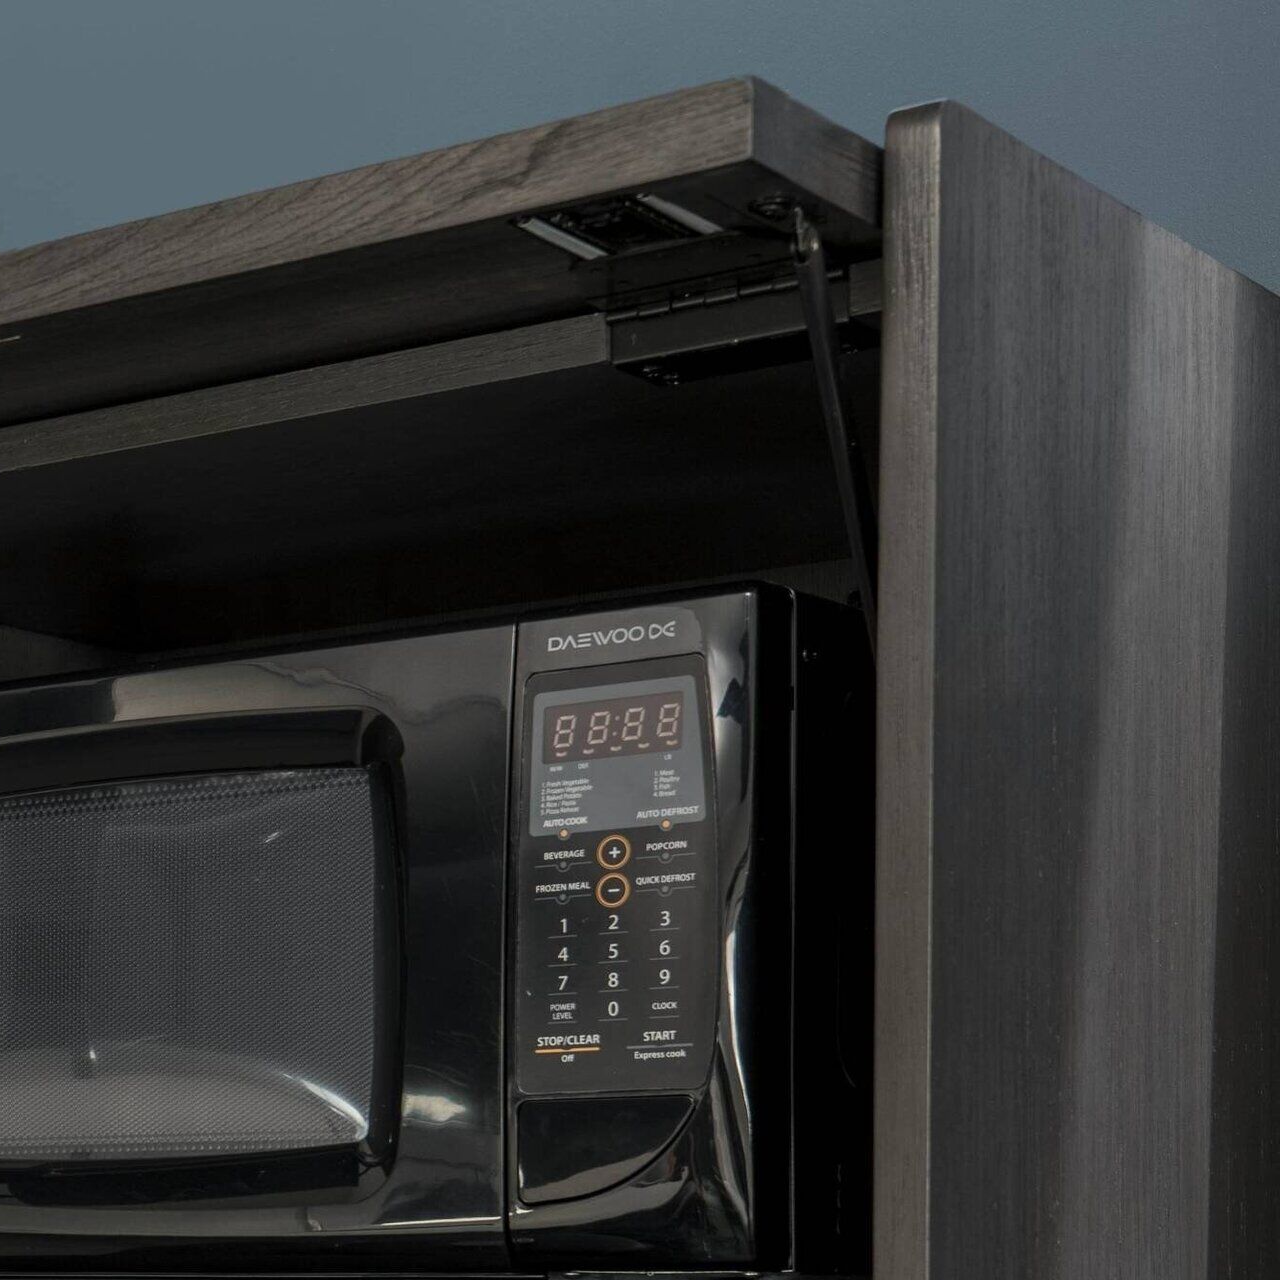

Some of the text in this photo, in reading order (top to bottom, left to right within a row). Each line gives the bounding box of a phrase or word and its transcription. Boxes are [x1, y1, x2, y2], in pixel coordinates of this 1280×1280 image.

[547, 626, 644, 652] DAEWOO
[636, 805, 699, 819] AUTO DEFROST
[543, 816, 588, 828] AUTO COOK
[645, 841, 687, 851] POPCORN
[543, 849, 585, 860] BEVERAGE
[635, 873, 696, 885] QUICK DEFROST
[535, 881, 591, 893] FROZEN MEAL
[608, 914, 619, 930] 2
[659, 910, 671, 926] 3
[559, 918, 567, 933] 1
[557, 946, 568, 961] 4
[608, 943, 619, 959] 5
[659, 940, 671, 955] 6
[557, 975, 568, 991] 7
[608, 972, 619, 988] 8
[659, 969, 671, 984] 9
[550, 1003, 576, 1012] POWER
[607, 1001, 619, 1016] 0
[651, 1001, 678, 1010] CLOCK
[552, 1012, 573, 1020] LEVEL
[537, 1034, 600, 1047] STOP/CLEAR
[643, 1030, 677, 1042] START
[561, 1054, 574, 1063] Off
[634, 1049, 686, 1061] Express cook
